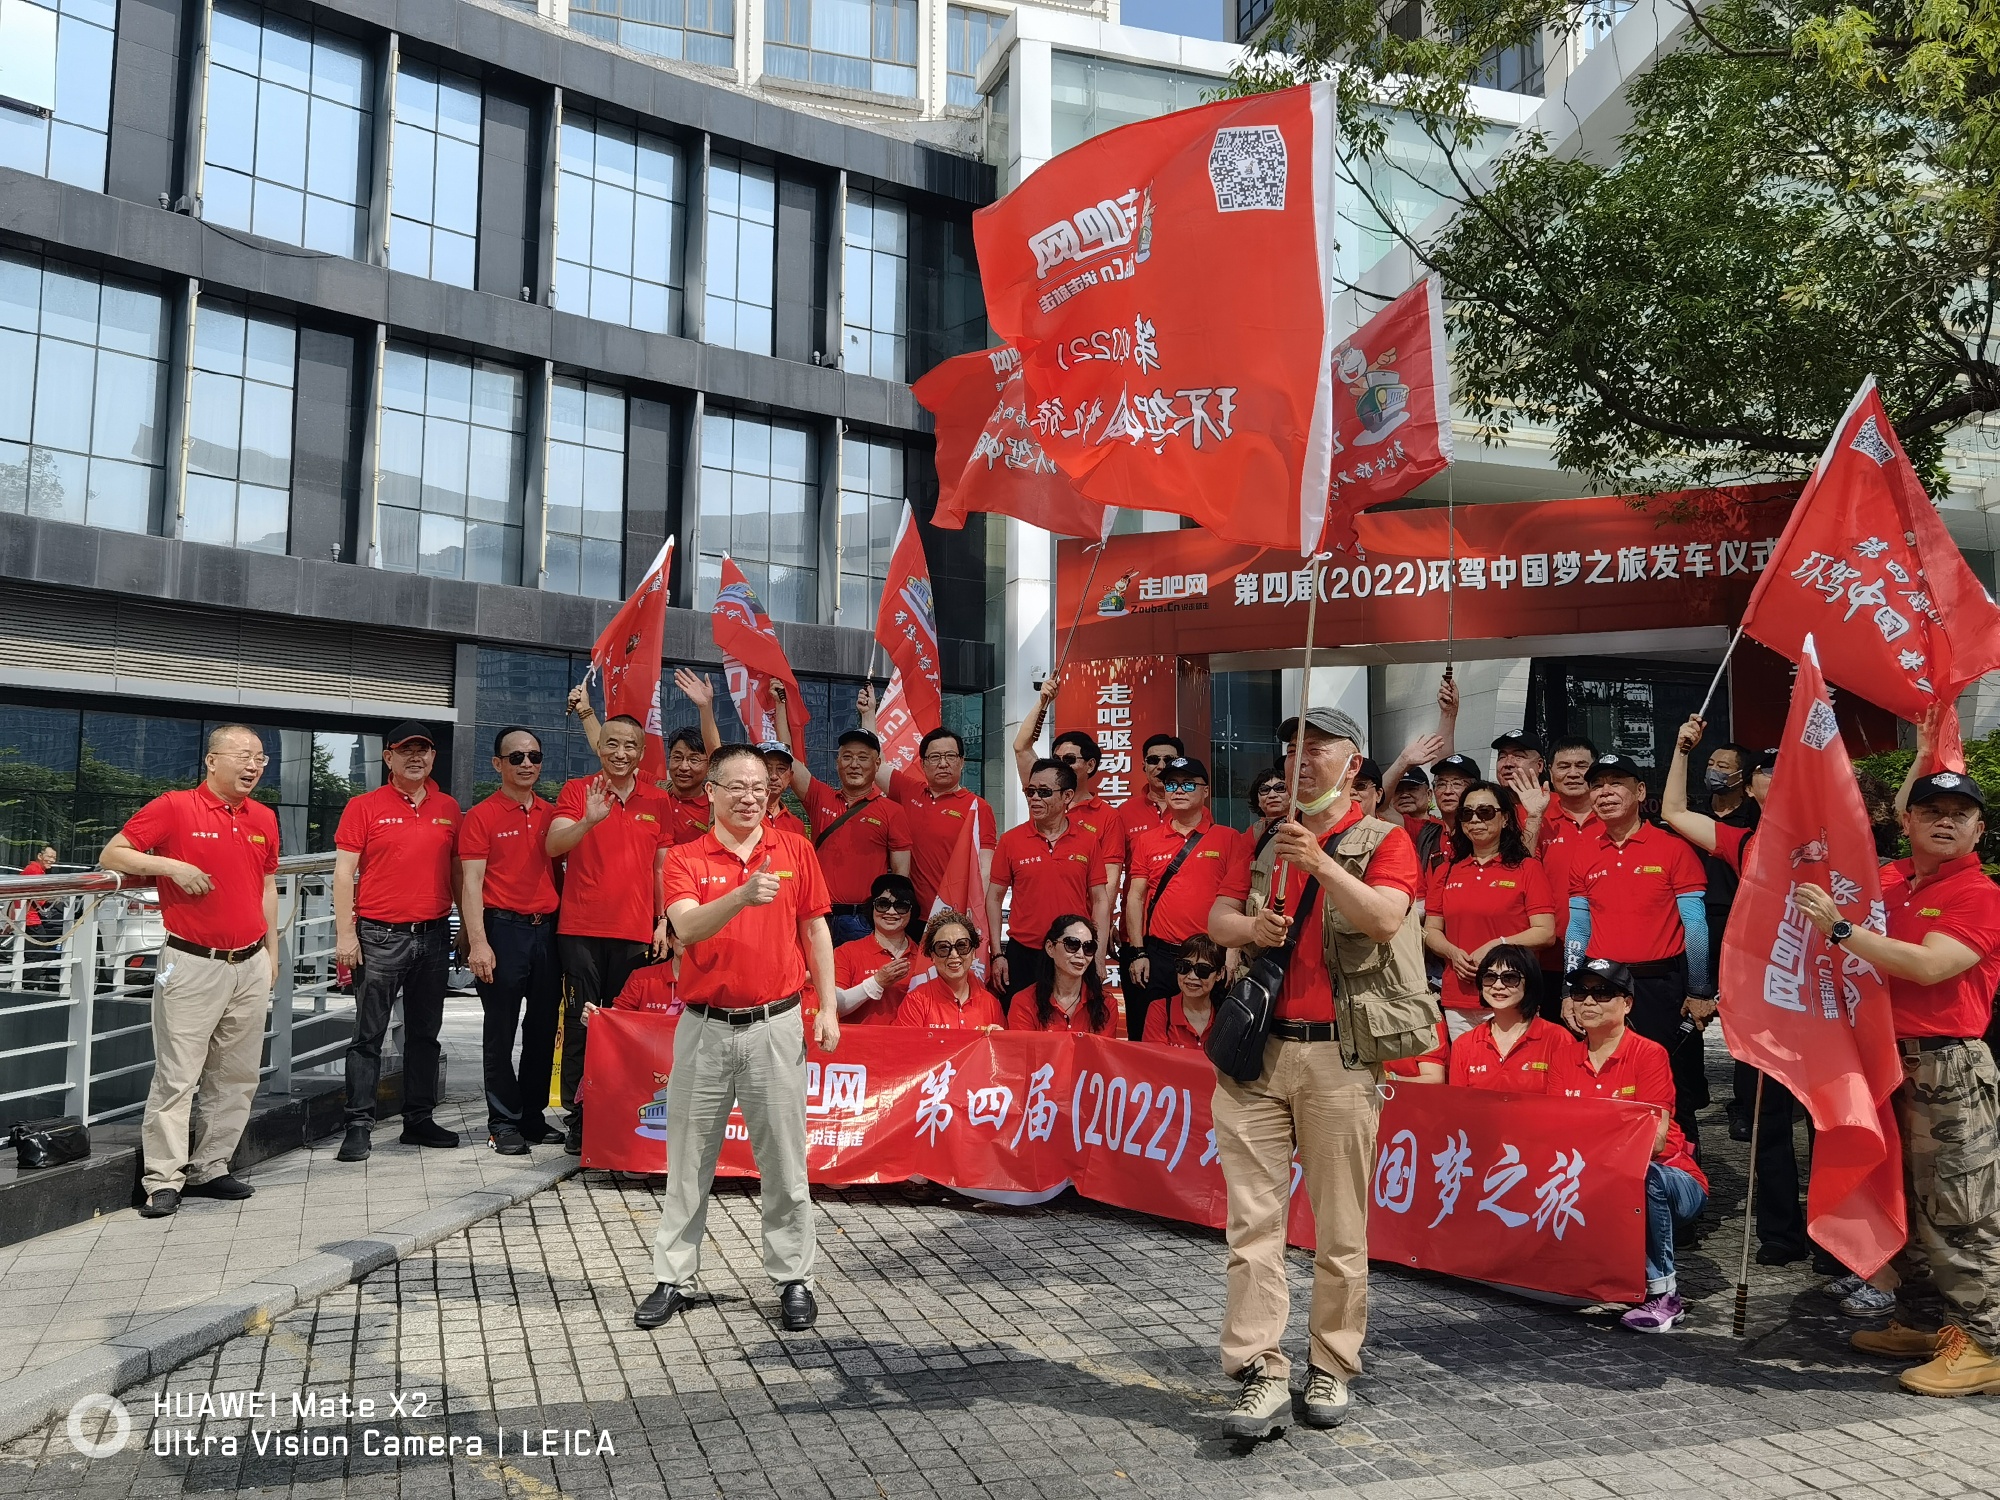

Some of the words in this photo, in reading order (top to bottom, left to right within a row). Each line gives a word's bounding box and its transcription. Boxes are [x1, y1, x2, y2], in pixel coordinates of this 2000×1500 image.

[1138, 573, 1208, 600] 走吧网
[1097, 682, 1133, 808] 走吧驱动生
